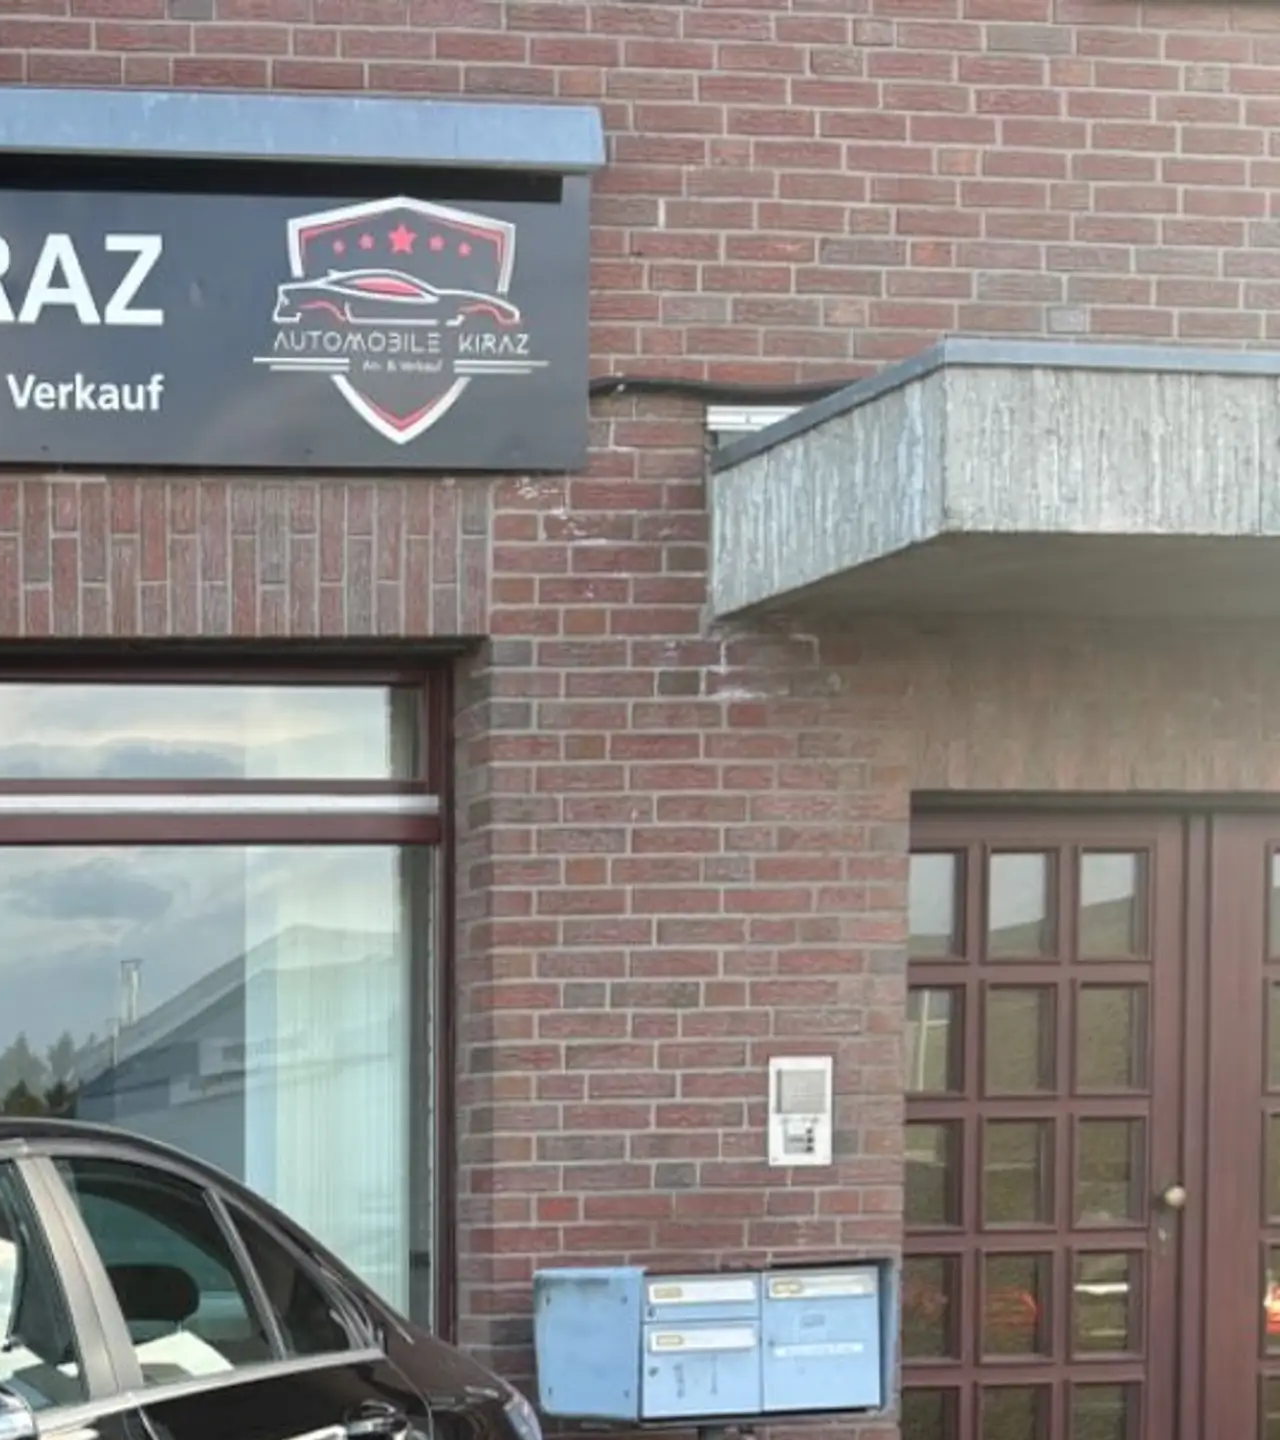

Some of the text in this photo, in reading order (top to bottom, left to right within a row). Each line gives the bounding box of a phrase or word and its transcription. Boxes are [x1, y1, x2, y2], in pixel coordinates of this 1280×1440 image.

[273, 330, 530, 354] AUTOMOBILE KIRAZ
[6, 372, 165, 412] Verkauf
